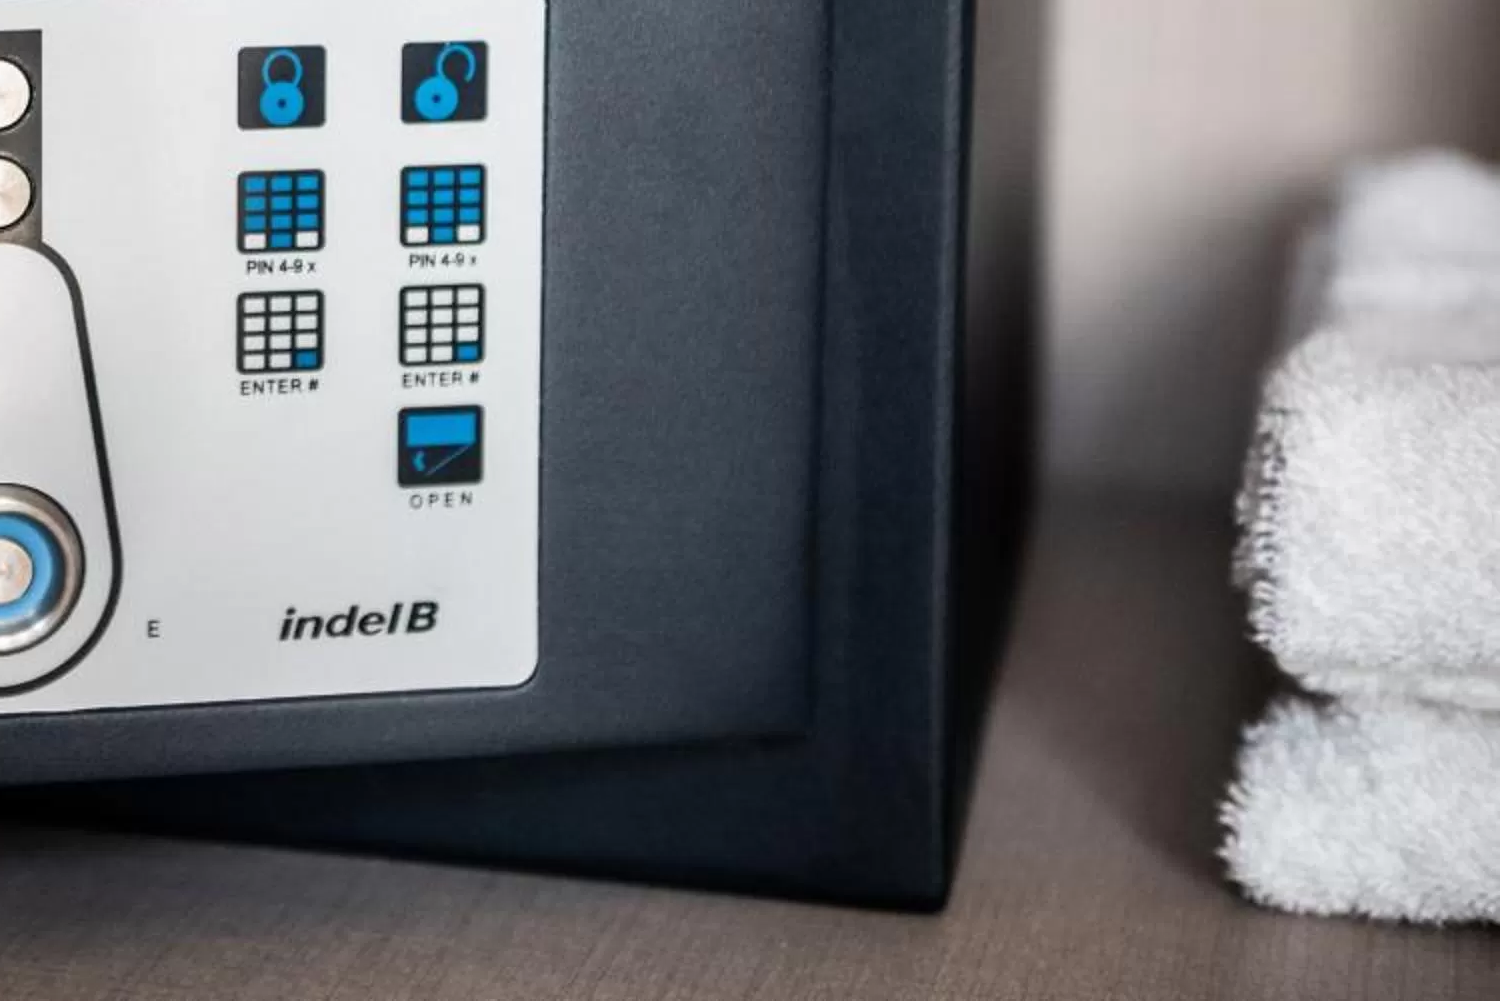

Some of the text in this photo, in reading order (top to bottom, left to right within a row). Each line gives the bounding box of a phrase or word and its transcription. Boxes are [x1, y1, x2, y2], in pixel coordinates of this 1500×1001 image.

[246, 260, 274, 274] PIN
[409, 254, 436, 268] PIN
[240, 378, 320, 396] ENTER #
[402, 371, 480, 388] ENTER #
[409, 490, 473, 510] OPEN
[148, 620, 160, 638] E
